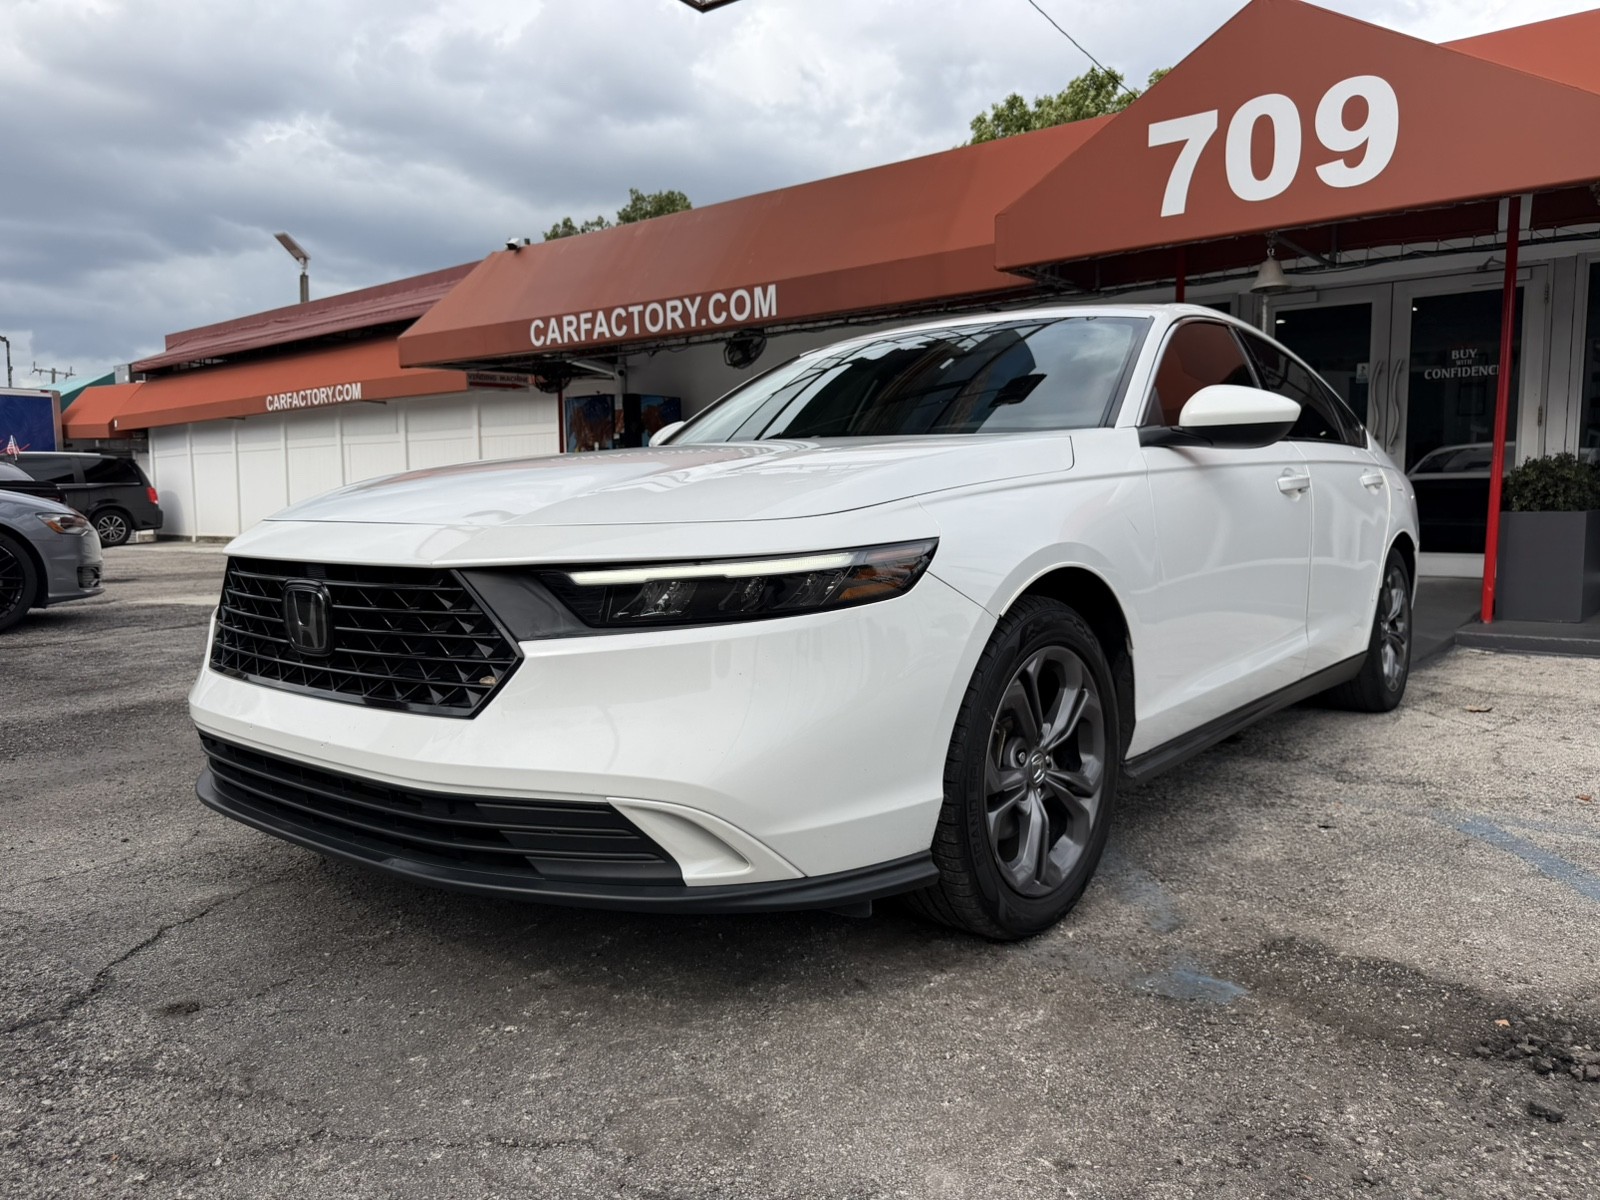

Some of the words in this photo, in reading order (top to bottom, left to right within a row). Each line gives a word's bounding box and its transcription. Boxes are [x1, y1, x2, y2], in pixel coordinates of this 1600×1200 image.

[1148, 75, 1399, 217] 709
[529, 284, 777, 347] CARFACTORY.COM
[1451, 349, 1477, 360] BUY
[266, 382, 361, 411] CARFACTORY.COM
